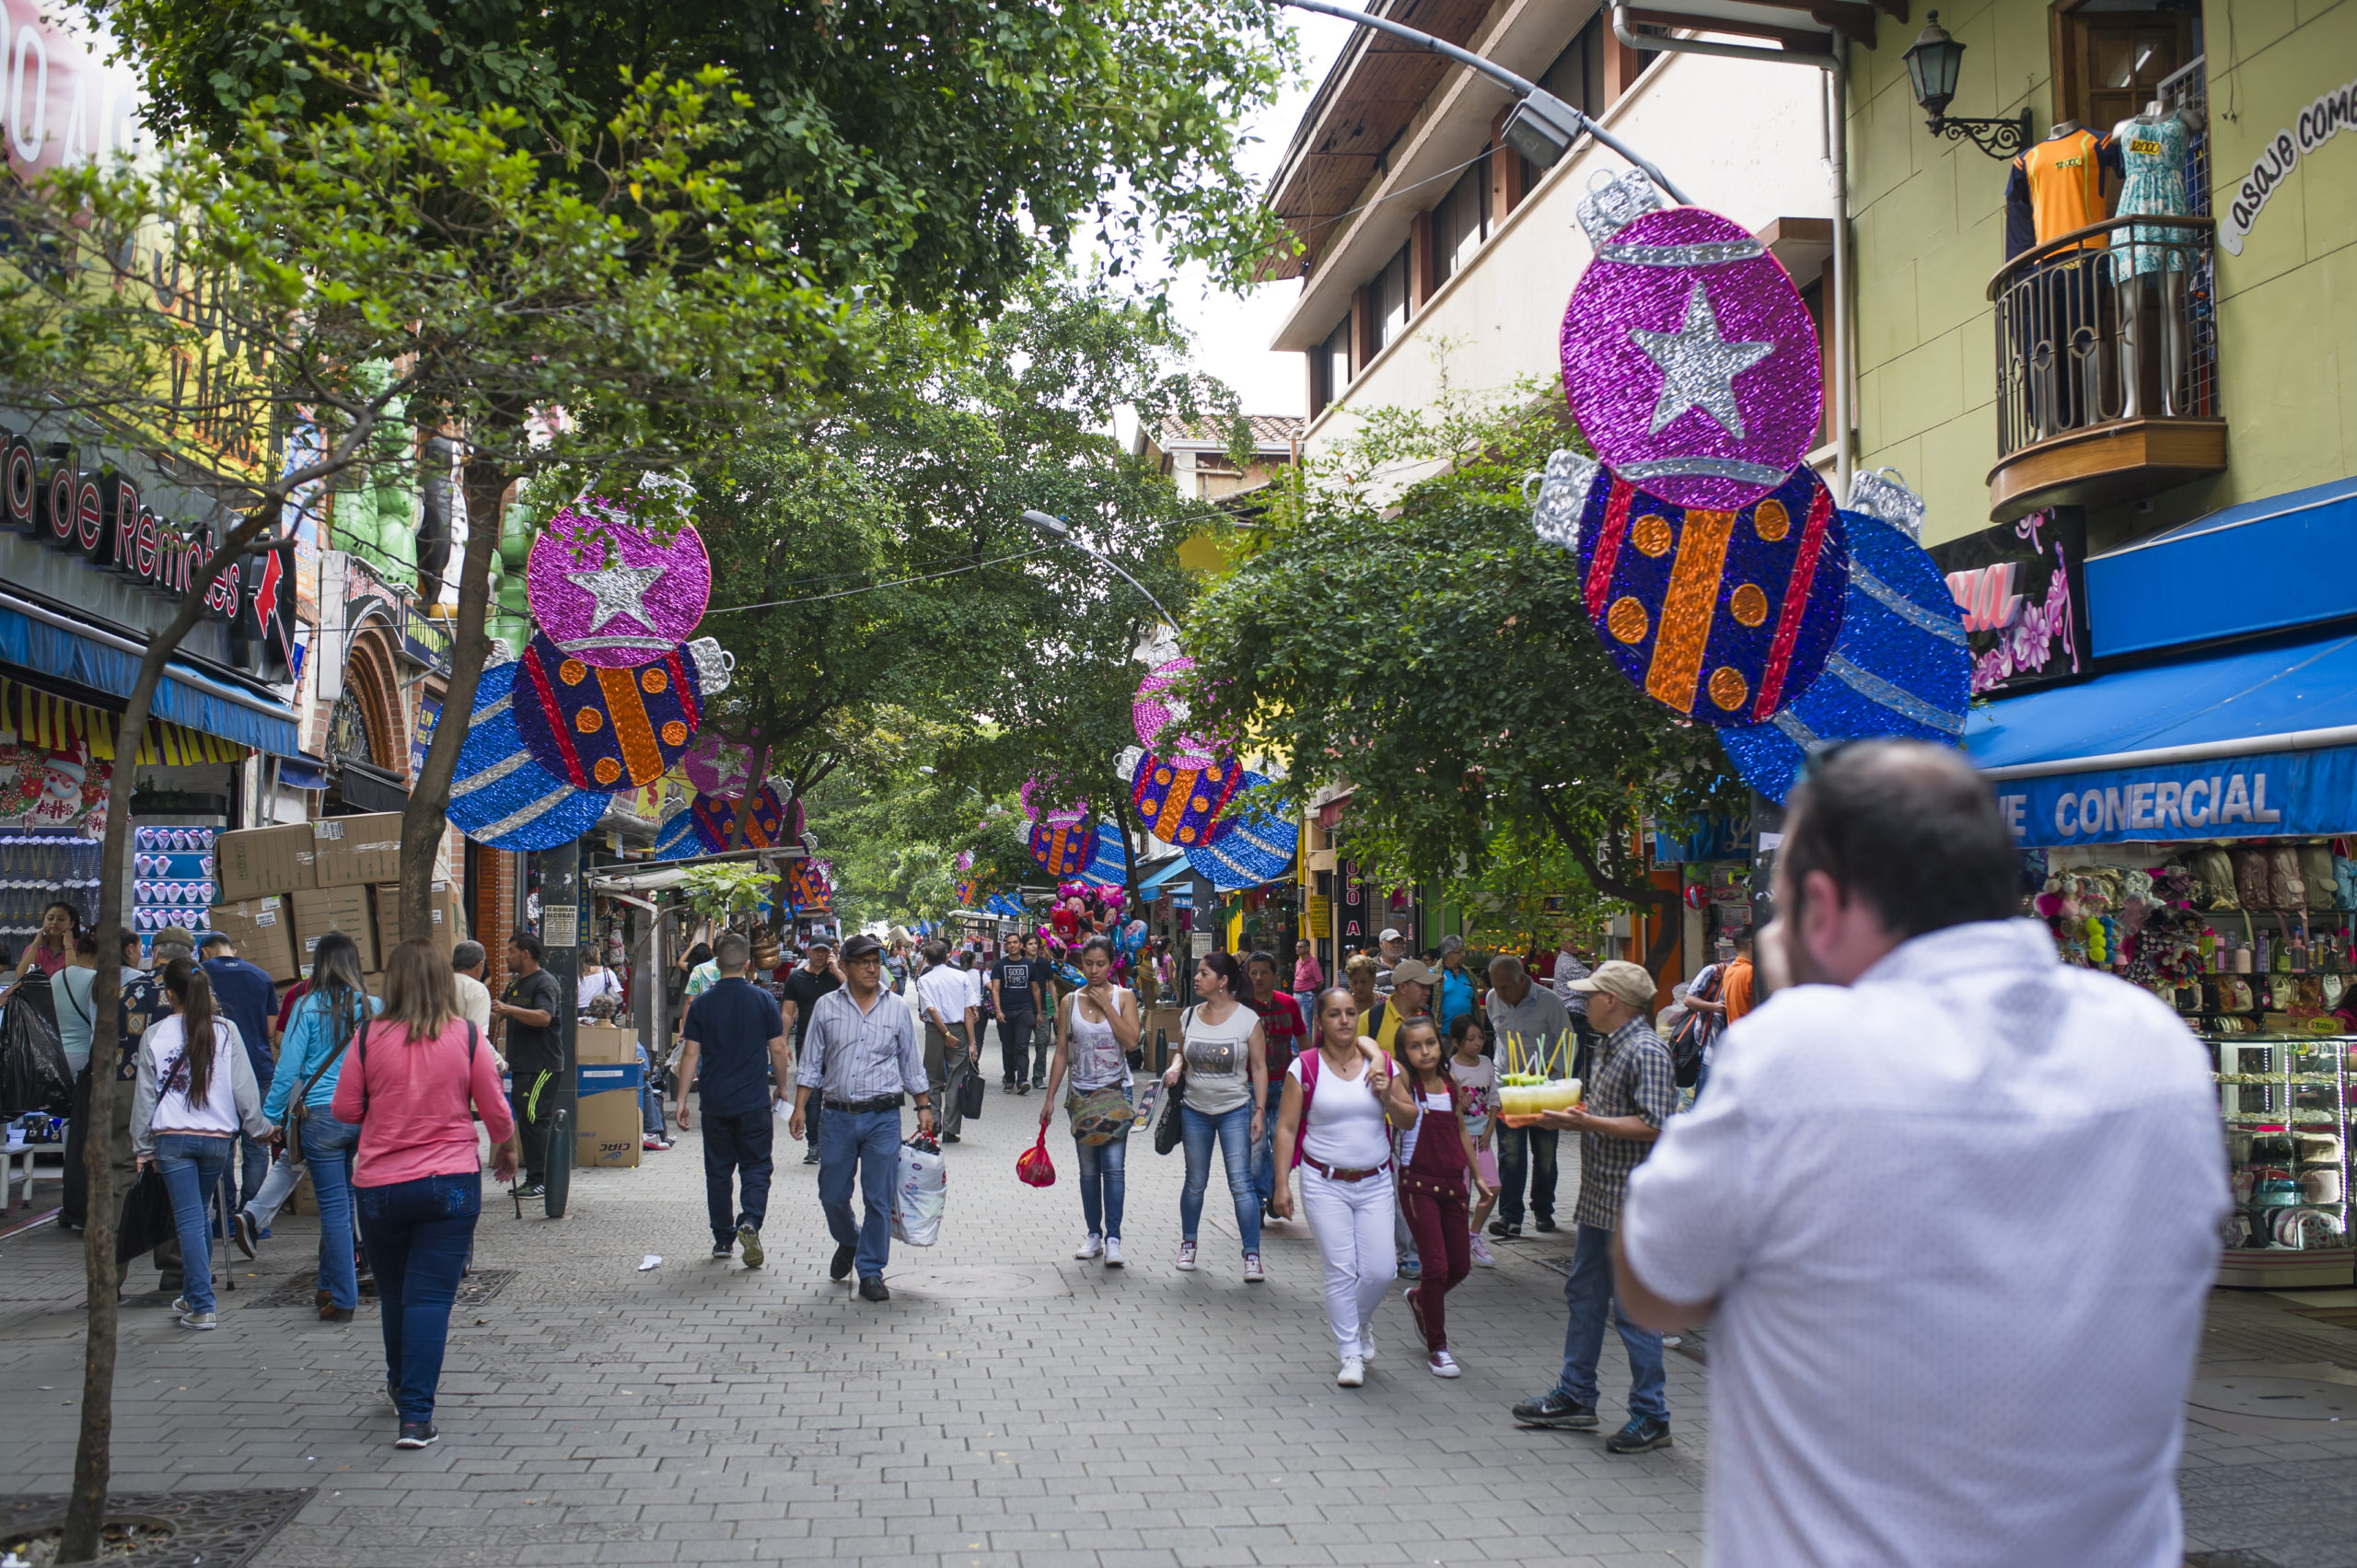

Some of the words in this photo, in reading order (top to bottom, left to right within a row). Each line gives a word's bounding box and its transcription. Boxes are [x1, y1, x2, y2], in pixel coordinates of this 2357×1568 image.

[50, 447, 101, 551] de
[1008, 968, 1025, 976] GOOD
[599, 1143, 631, 1152] CIAC
